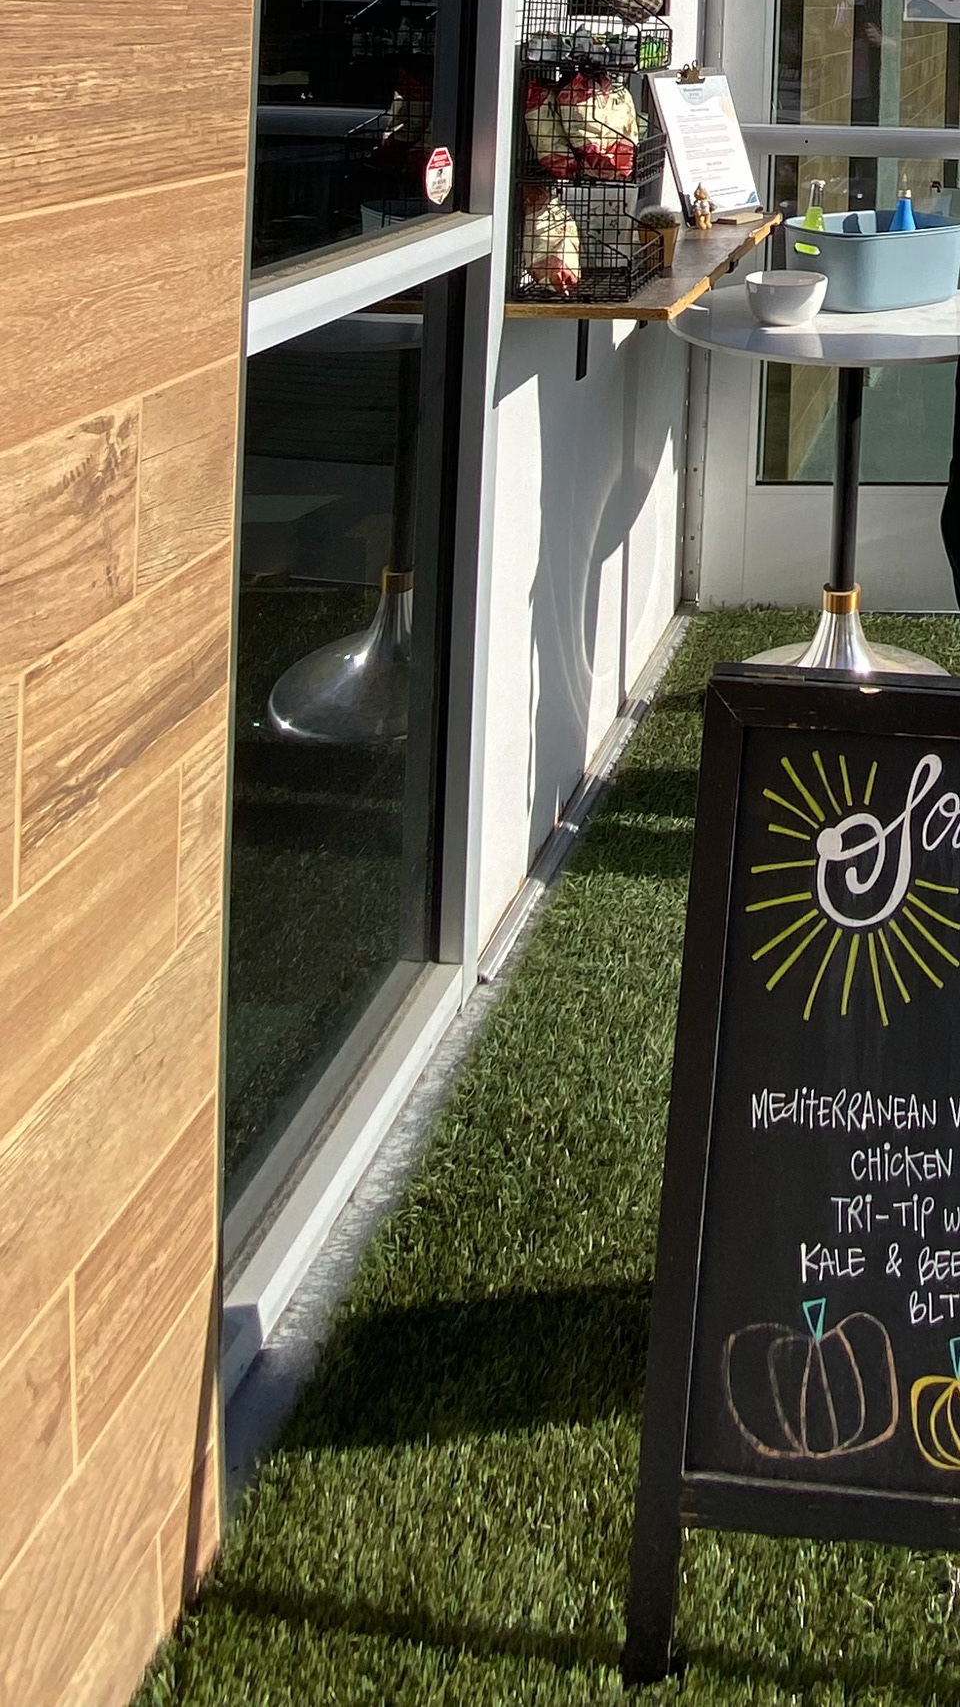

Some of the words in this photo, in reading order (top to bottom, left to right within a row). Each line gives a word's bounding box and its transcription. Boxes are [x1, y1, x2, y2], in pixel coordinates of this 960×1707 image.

[801, 1243, 865, 1283] KALE
[886, 1243, 902, 1277] &
[910, 1291, 959, 1324] BLT
